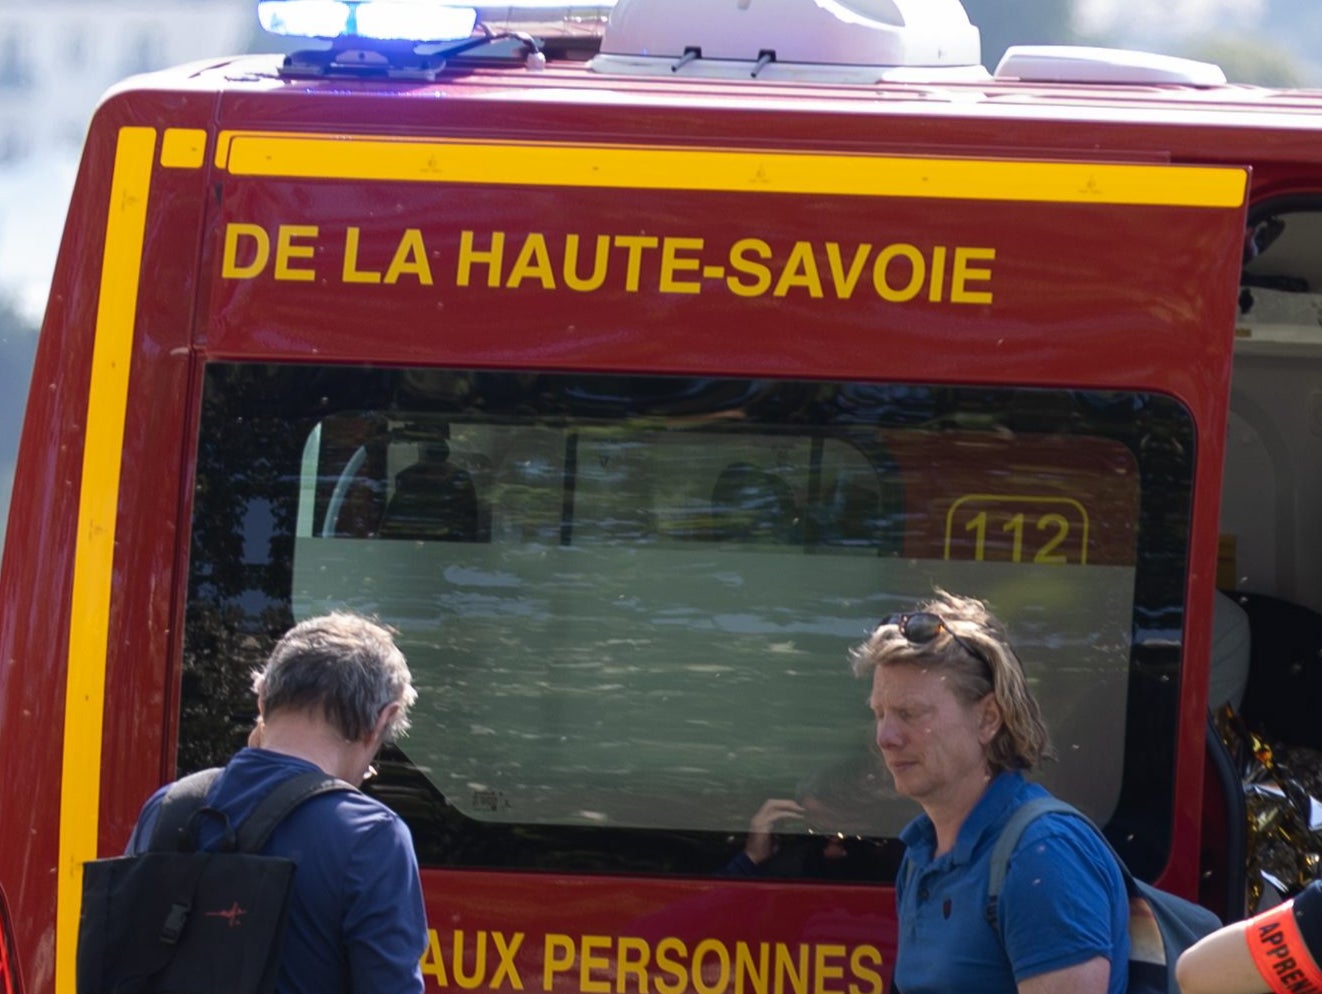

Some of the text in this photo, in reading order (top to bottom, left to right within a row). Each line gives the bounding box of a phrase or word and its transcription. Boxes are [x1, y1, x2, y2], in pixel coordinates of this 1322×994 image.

[221, 222, 997, 305] DE LA HAUTE-SAVOIE
[965, 511, 1070, 564] 112
[420, 928, 526, 991] AUX
